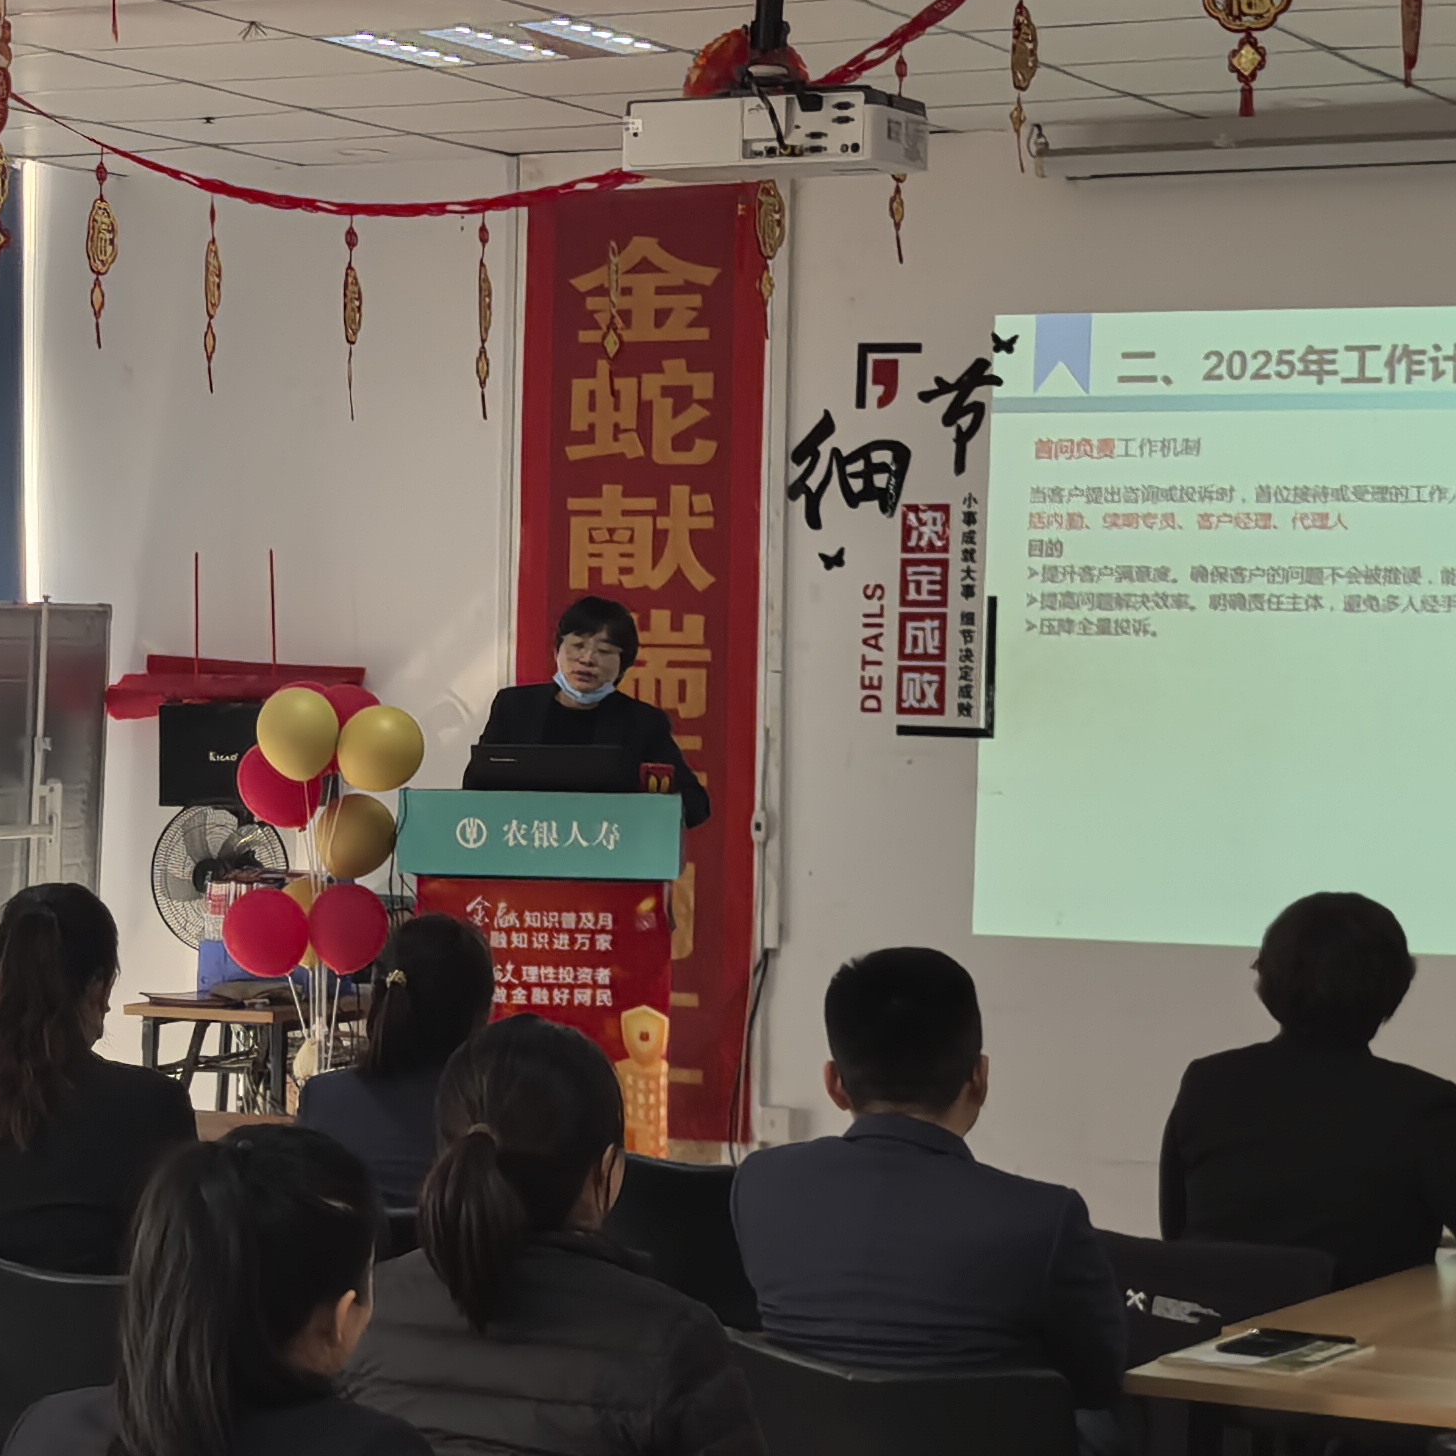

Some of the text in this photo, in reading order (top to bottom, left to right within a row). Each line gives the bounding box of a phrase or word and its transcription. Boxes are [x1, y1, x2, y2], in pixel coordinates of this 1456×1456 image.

[1034, 437, 1201, 460] 首问负责工作机制
[860, 582, 885, 713] DETAILS
[901, 507, 948, 711] 决定成败
[503, 820, 621, 850] 农银人寿
